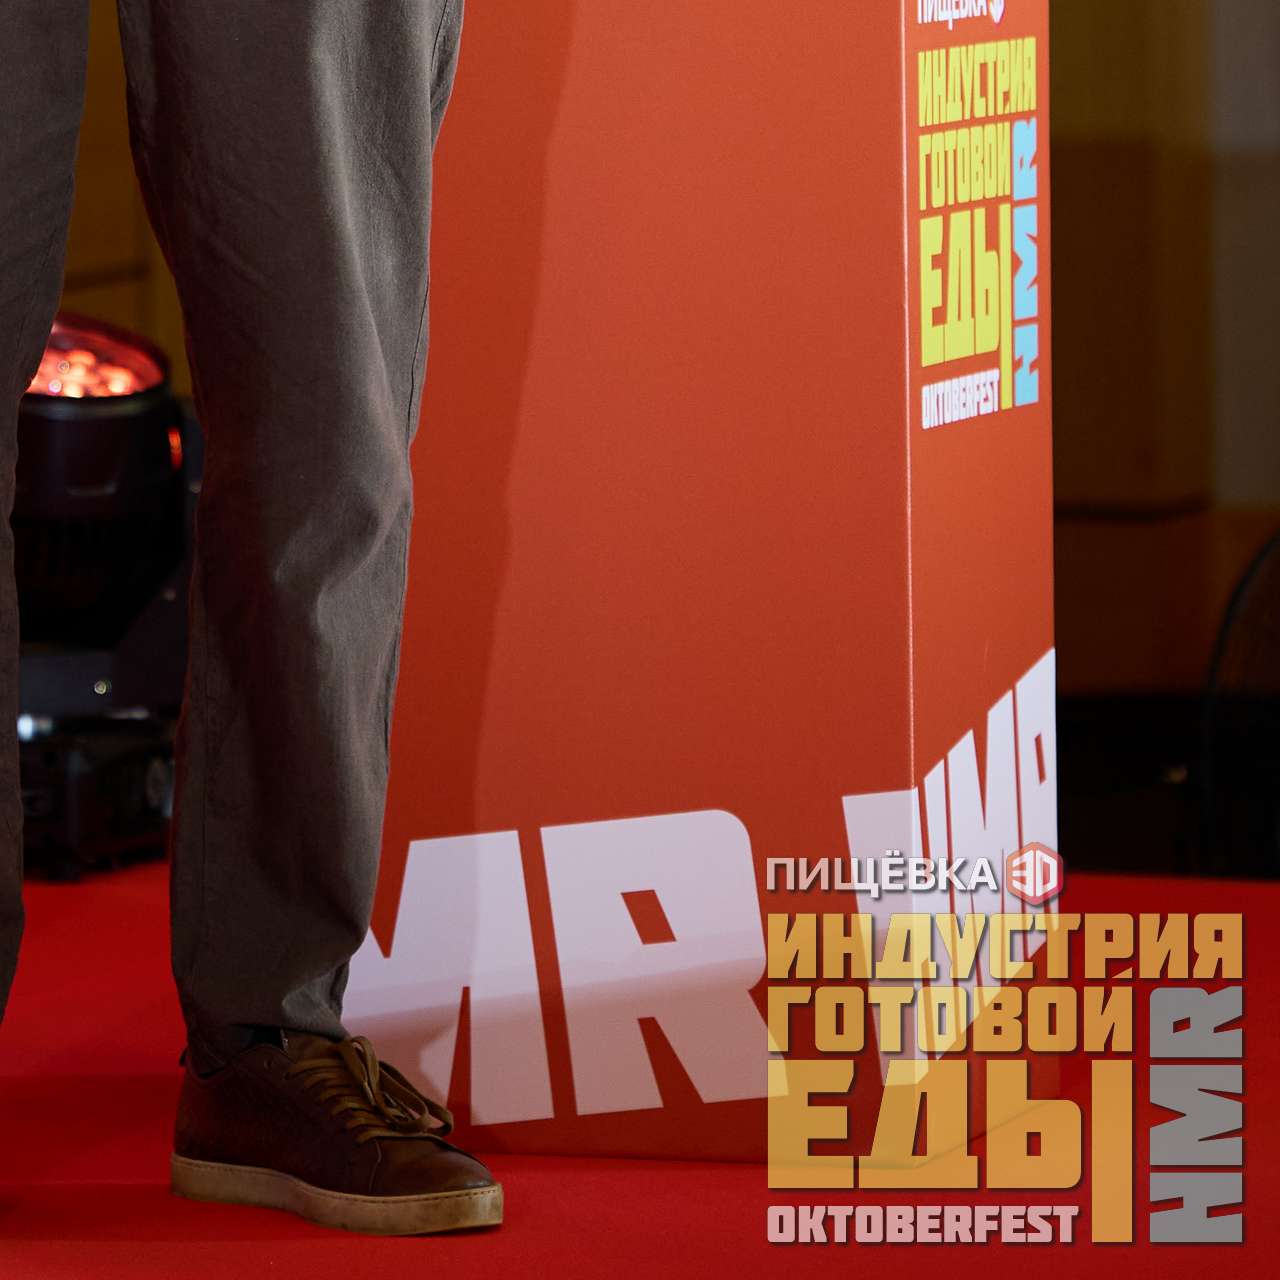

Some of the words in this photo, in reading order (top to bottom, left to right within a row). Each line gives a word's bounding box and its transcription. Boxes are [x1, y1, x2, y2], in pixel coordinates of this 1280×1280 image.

[917, 36, 1037, 127] ИНДУСТРИЯ
[920, 203, 1013, 410] ЕДЫ
[1013, 117, 1039, 407] HMR
[921, 368, 1000, 430] OKTOBERFEST
